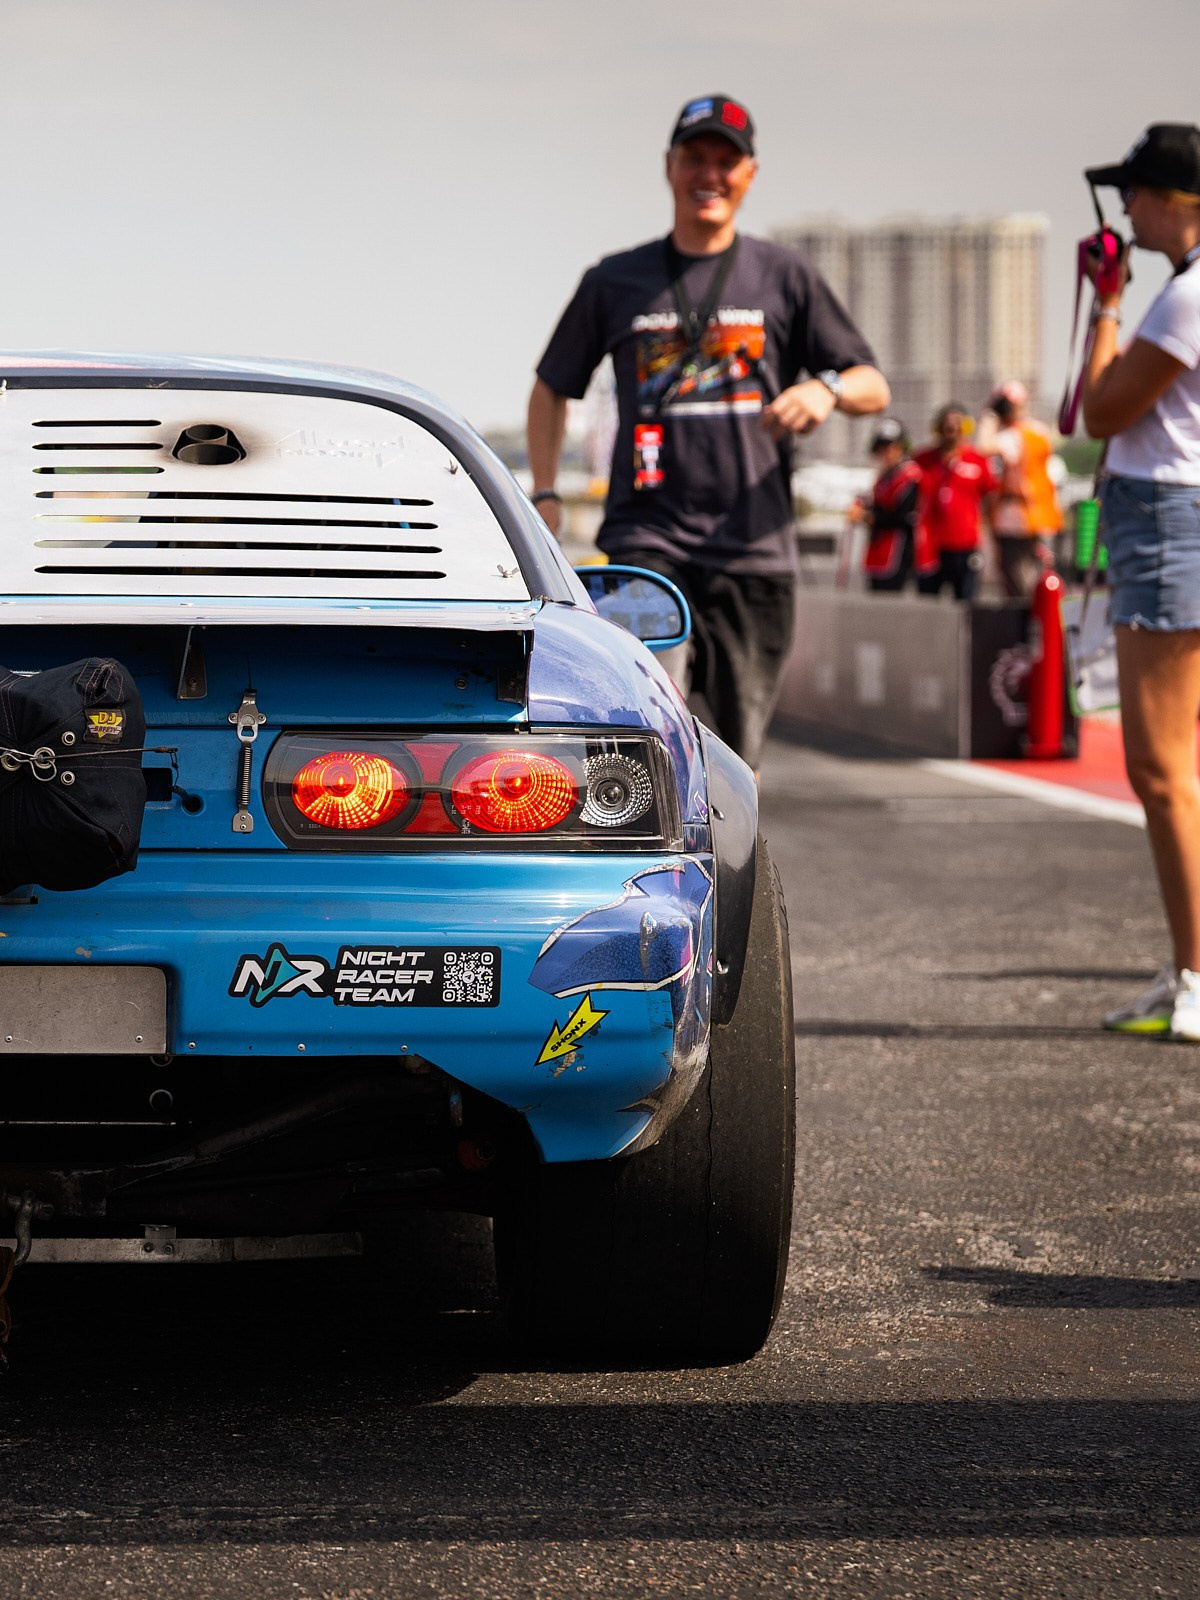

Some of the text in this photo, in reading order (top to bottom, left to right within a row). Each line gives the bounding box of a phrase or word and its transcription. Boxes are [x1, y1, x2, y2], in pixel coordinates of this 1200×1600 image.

[341, 951, 426, 966] NIGHT
[336, 969, 434, 985] RACER
[334, 987, 416, 1003] TEAM
[550, 1017, 587, 1053] SHONX
